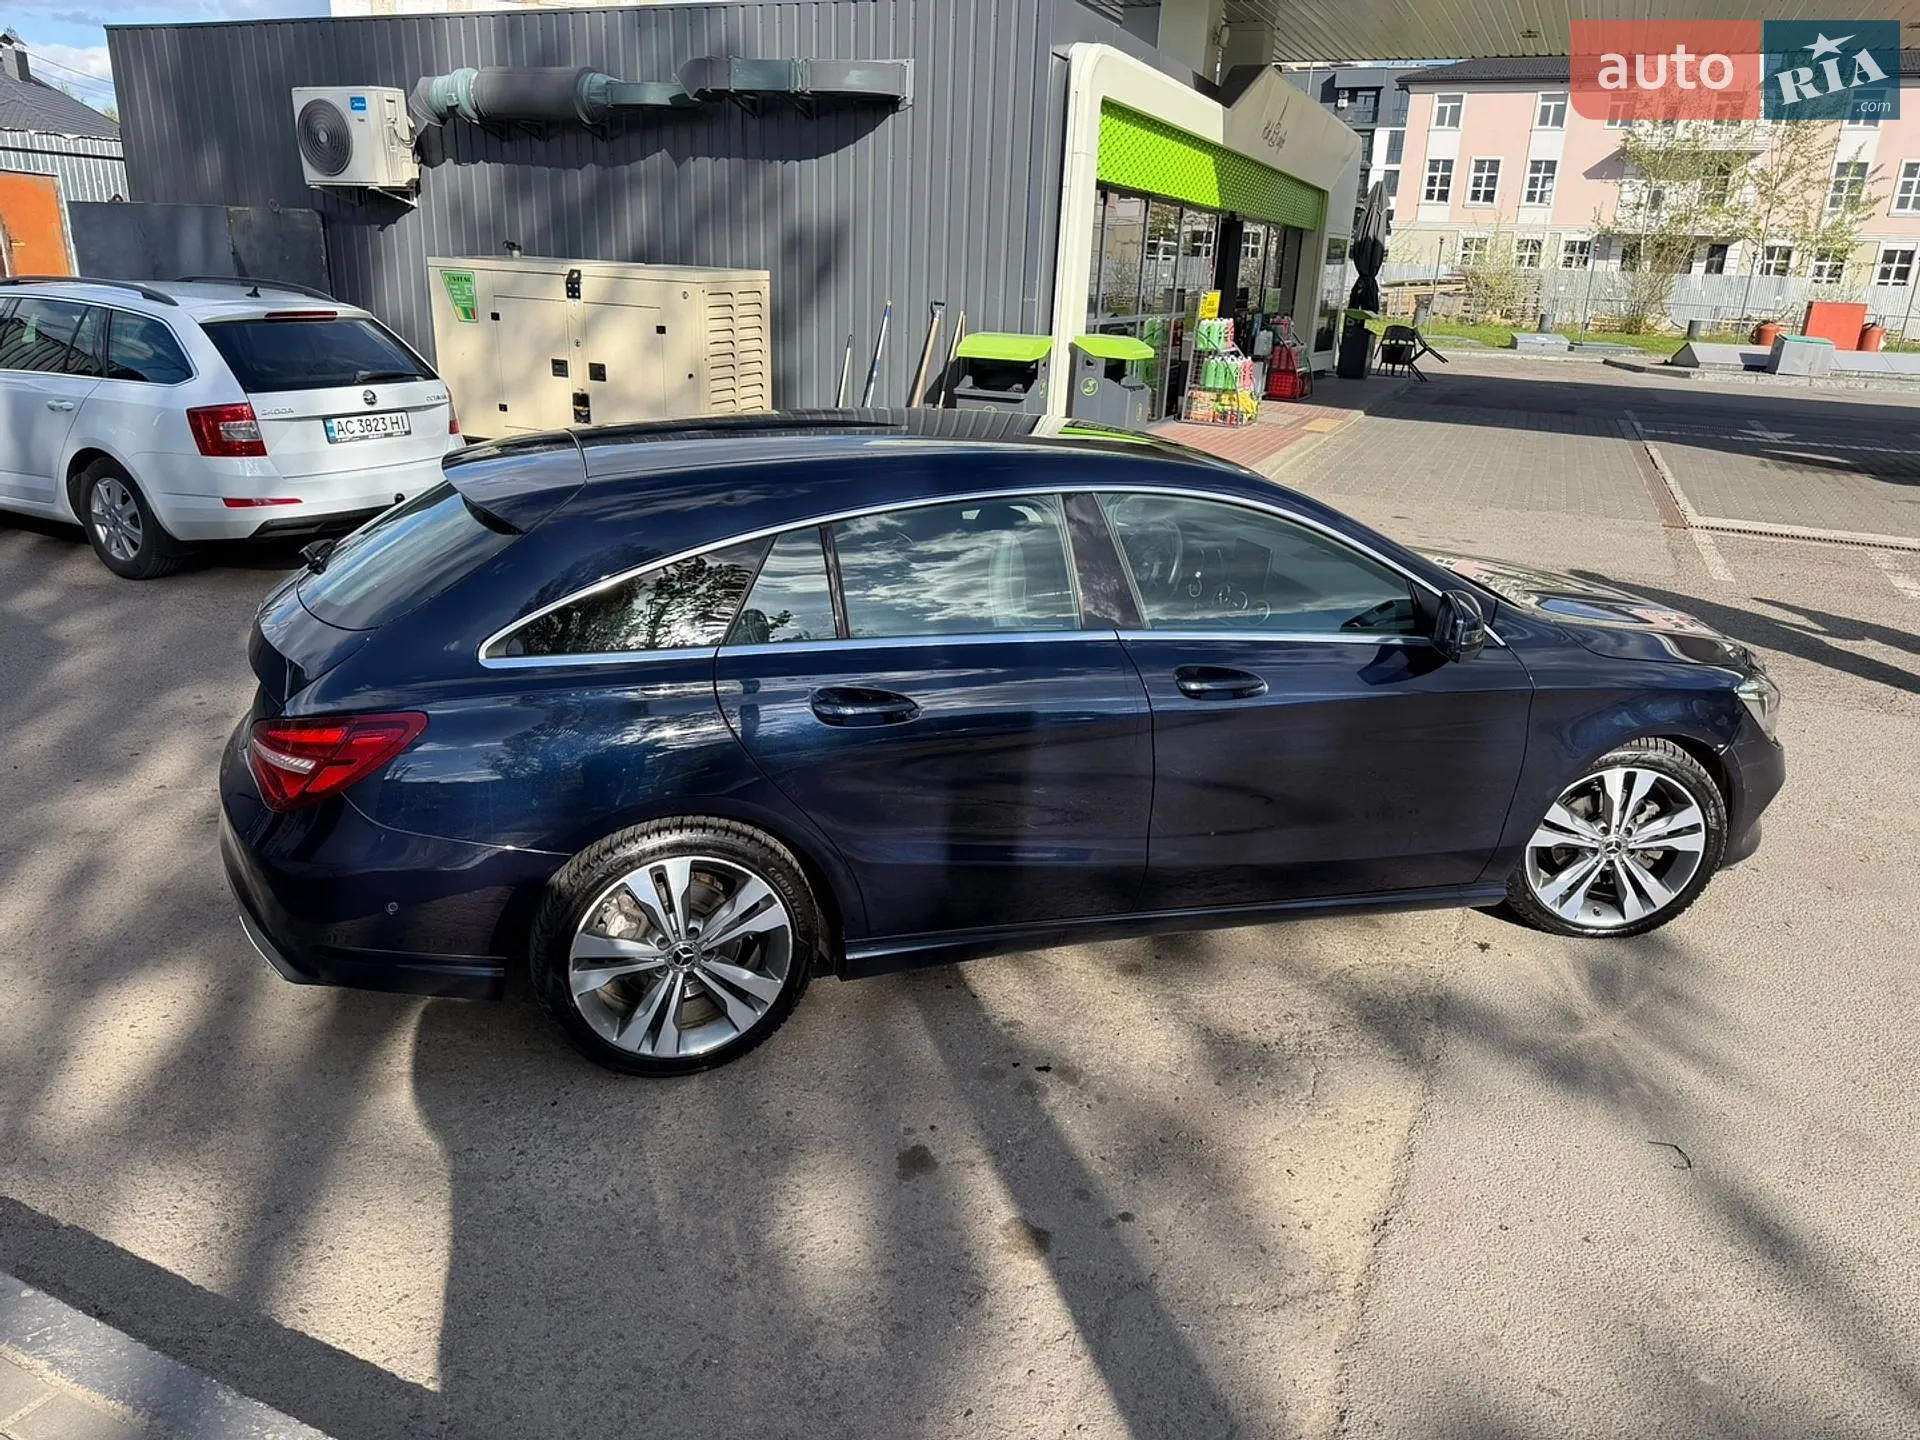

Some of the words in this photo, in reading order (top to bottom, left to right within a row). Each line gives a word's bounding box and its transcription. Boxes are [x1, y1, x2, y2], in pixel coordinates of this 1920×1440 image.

[337, 420, 355, 436] AC
[357, 417, 387, 433] 3823
[389, 415, 405, 430] HI
